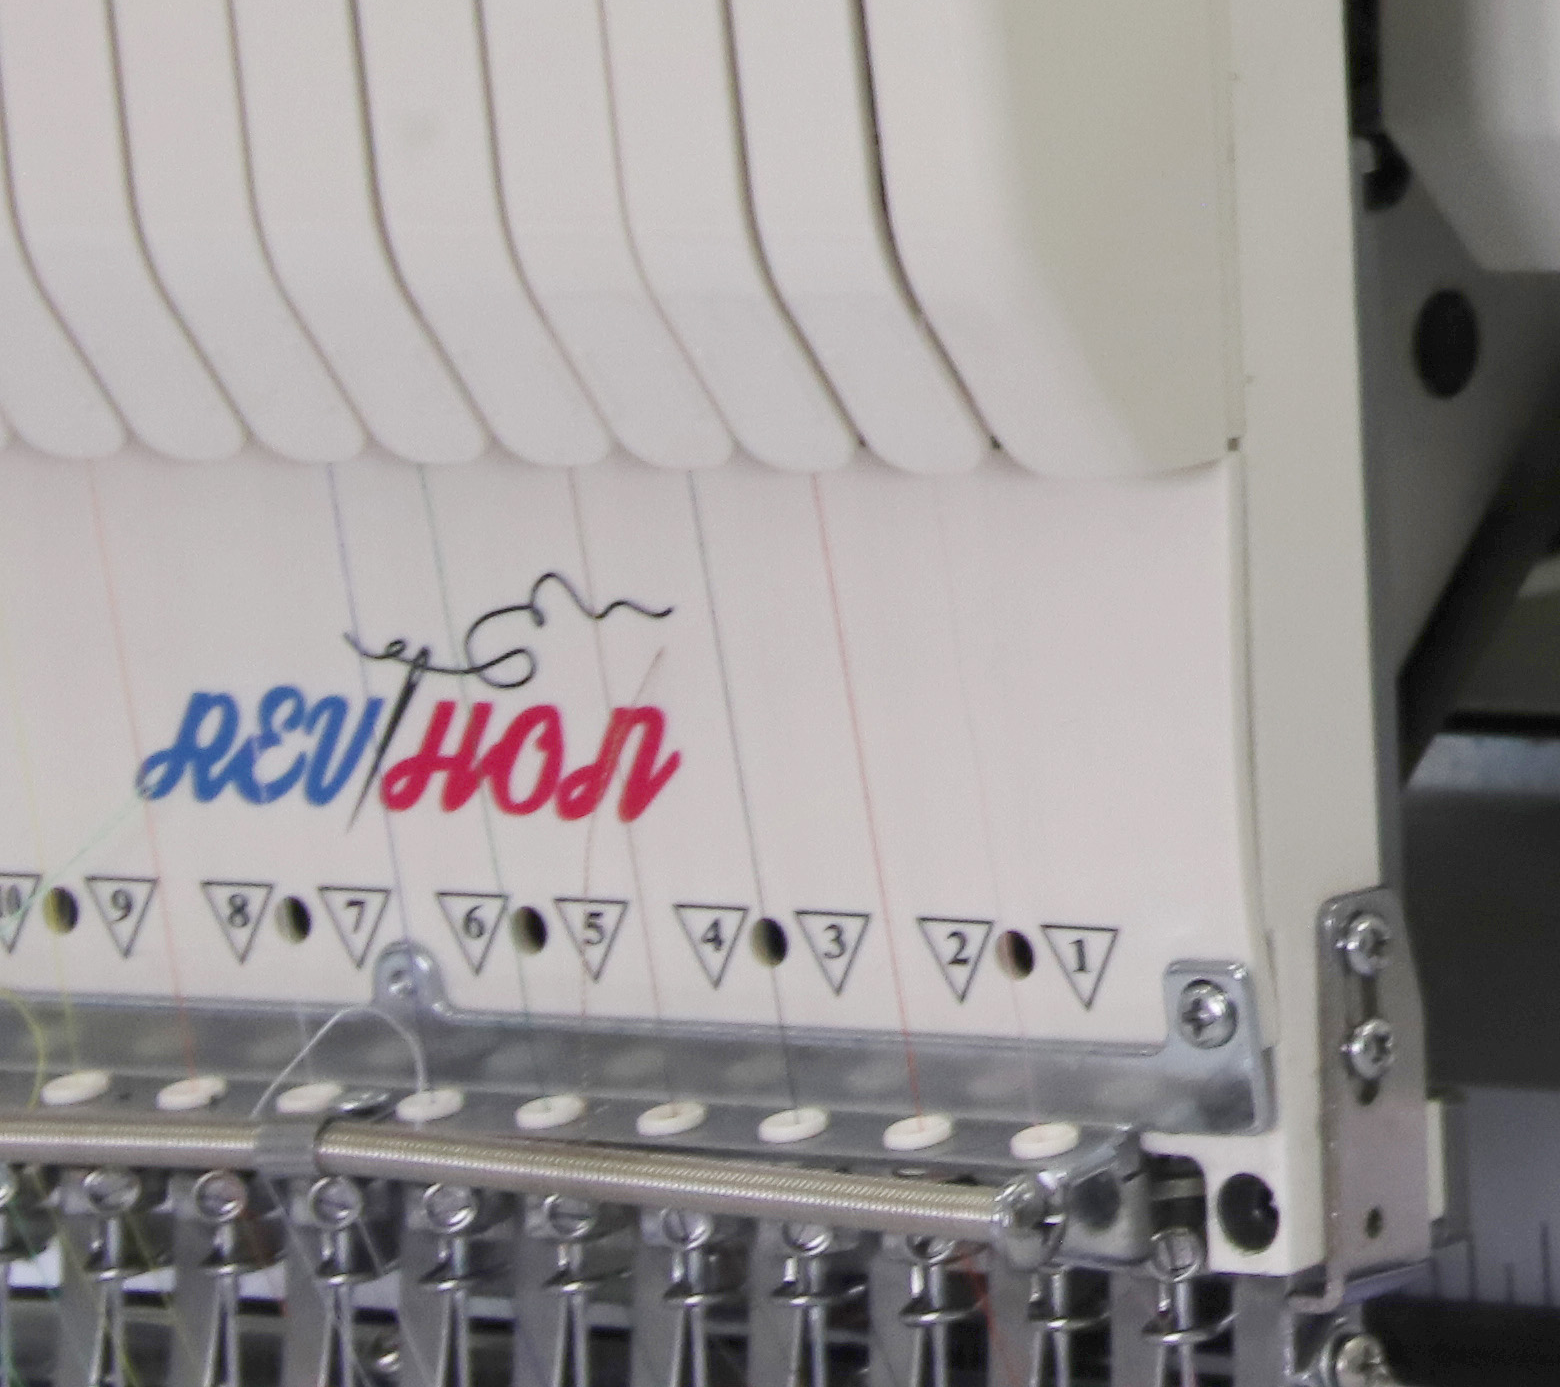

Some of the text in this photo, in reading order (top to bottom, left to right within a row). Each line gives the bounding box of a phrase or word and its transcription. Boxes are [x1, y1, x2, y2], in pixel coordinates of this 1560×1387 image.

[110, 888, 133, 922] 9
[227, 893, 250, 928] 8
[345, 898, 366, 933] 7
[462, 904, 485, 939] 6
[582, 911, 605, 946] 5
[701, 917, 723, 952] 4
[823, 923, 847, 959] 3
[945, 931, 971, 965] 2
[1067, 938, 1092, 973] 1
